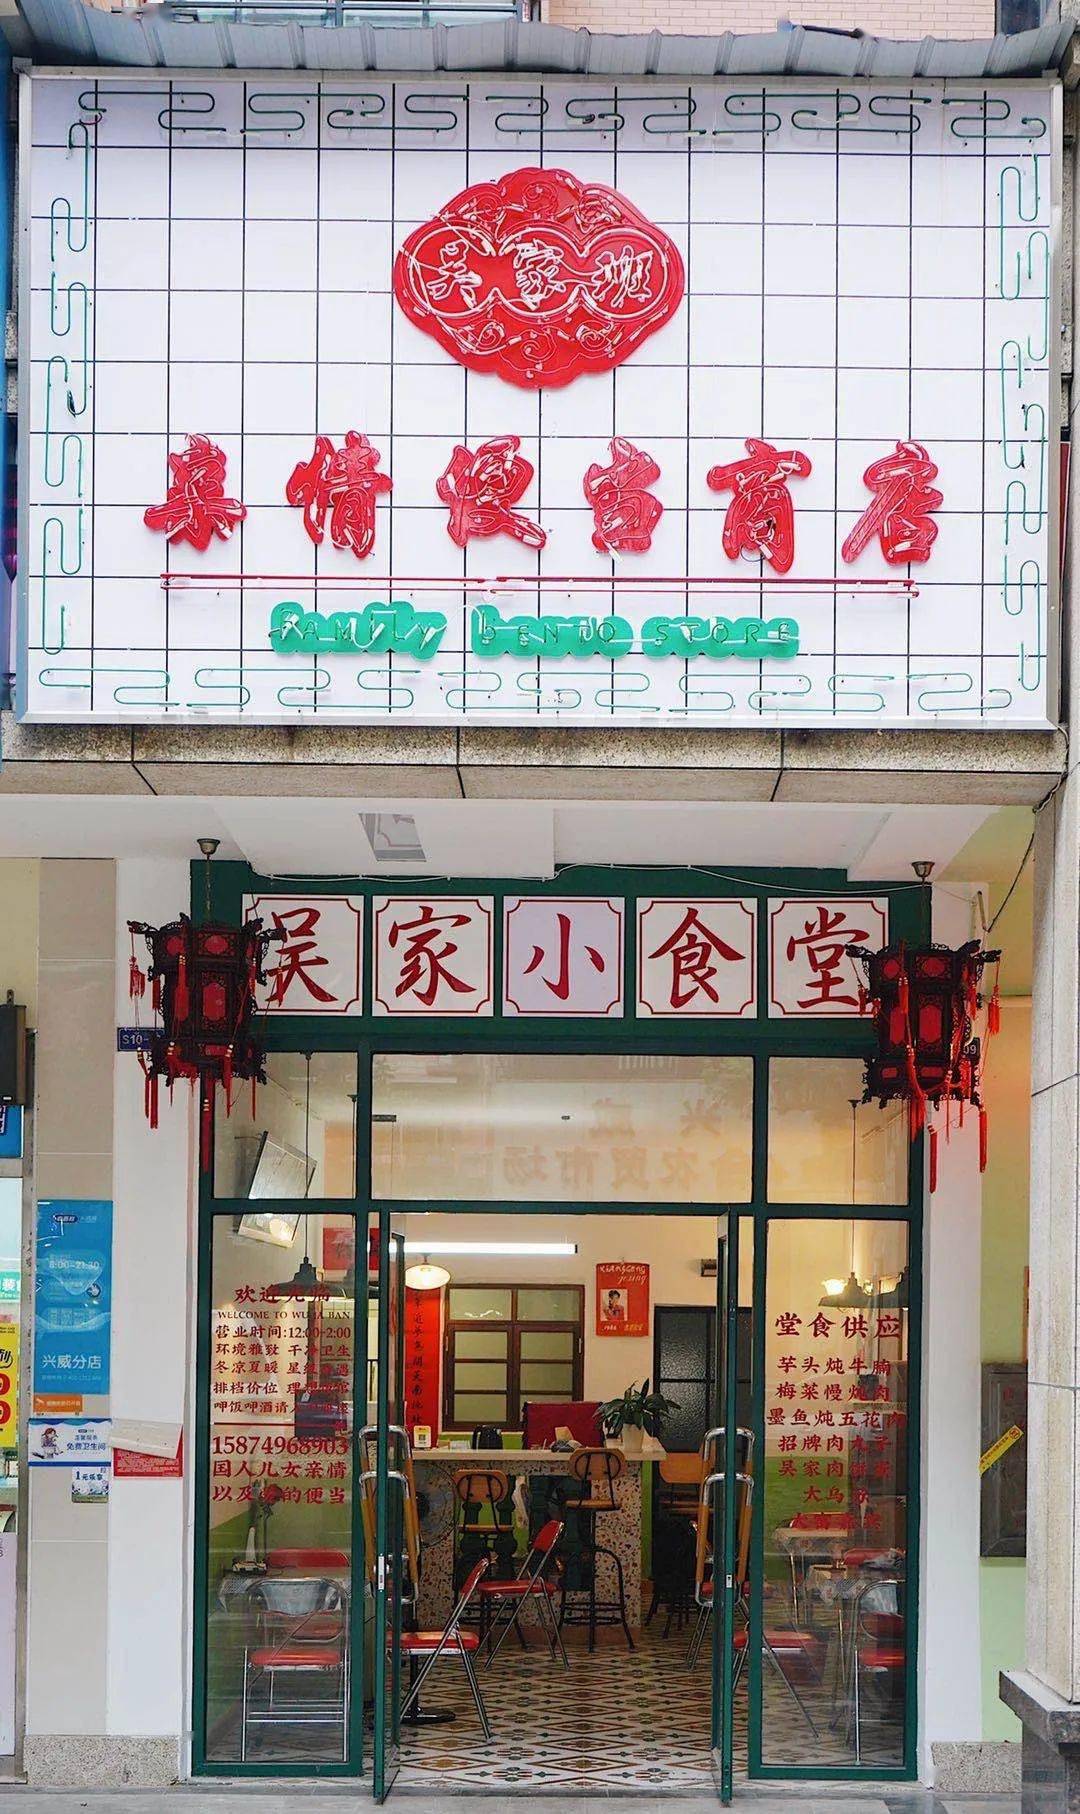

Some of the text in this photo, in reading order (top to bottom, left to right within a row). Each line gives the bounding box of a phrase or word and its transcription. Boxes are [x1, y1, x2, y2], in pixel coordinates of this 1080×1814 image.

[266, 906, 871, 1008] 吴家小食堂
[217, 1311, 269, 1319] WELCOME
[274, 1311, 288, 1319] TO
[328, 1311, 350, 1319] BAN
[774, 1311, 903, 1339] 堂食供应
[215, 1343, 351, 1357] 环境雅致 干净卫生
[41, 1354, 102, 1369] 兴威分店
[213, 1360, 350, 1377] 冬凉夏暖 星级遇
[776, 1355, 892, 1376] 芋头炖牛腩
[213, 1381, 278, 1395] 排档价位
[775, 1381, 891, 1402] 梅菜慢炖肉
[766, 1407, 906, 1429] 墨鱼炖五花肉
[66, 1442, 106, 1451] 免费卫生间
[212, 1435, 349, 1455] 15874968903
[778, 1434, 892, 1452] 招牌肉丸子
[212, 1459, 347, 1479] 国人儿女亲情
[803, 1485, 870, 1506] 大乌
